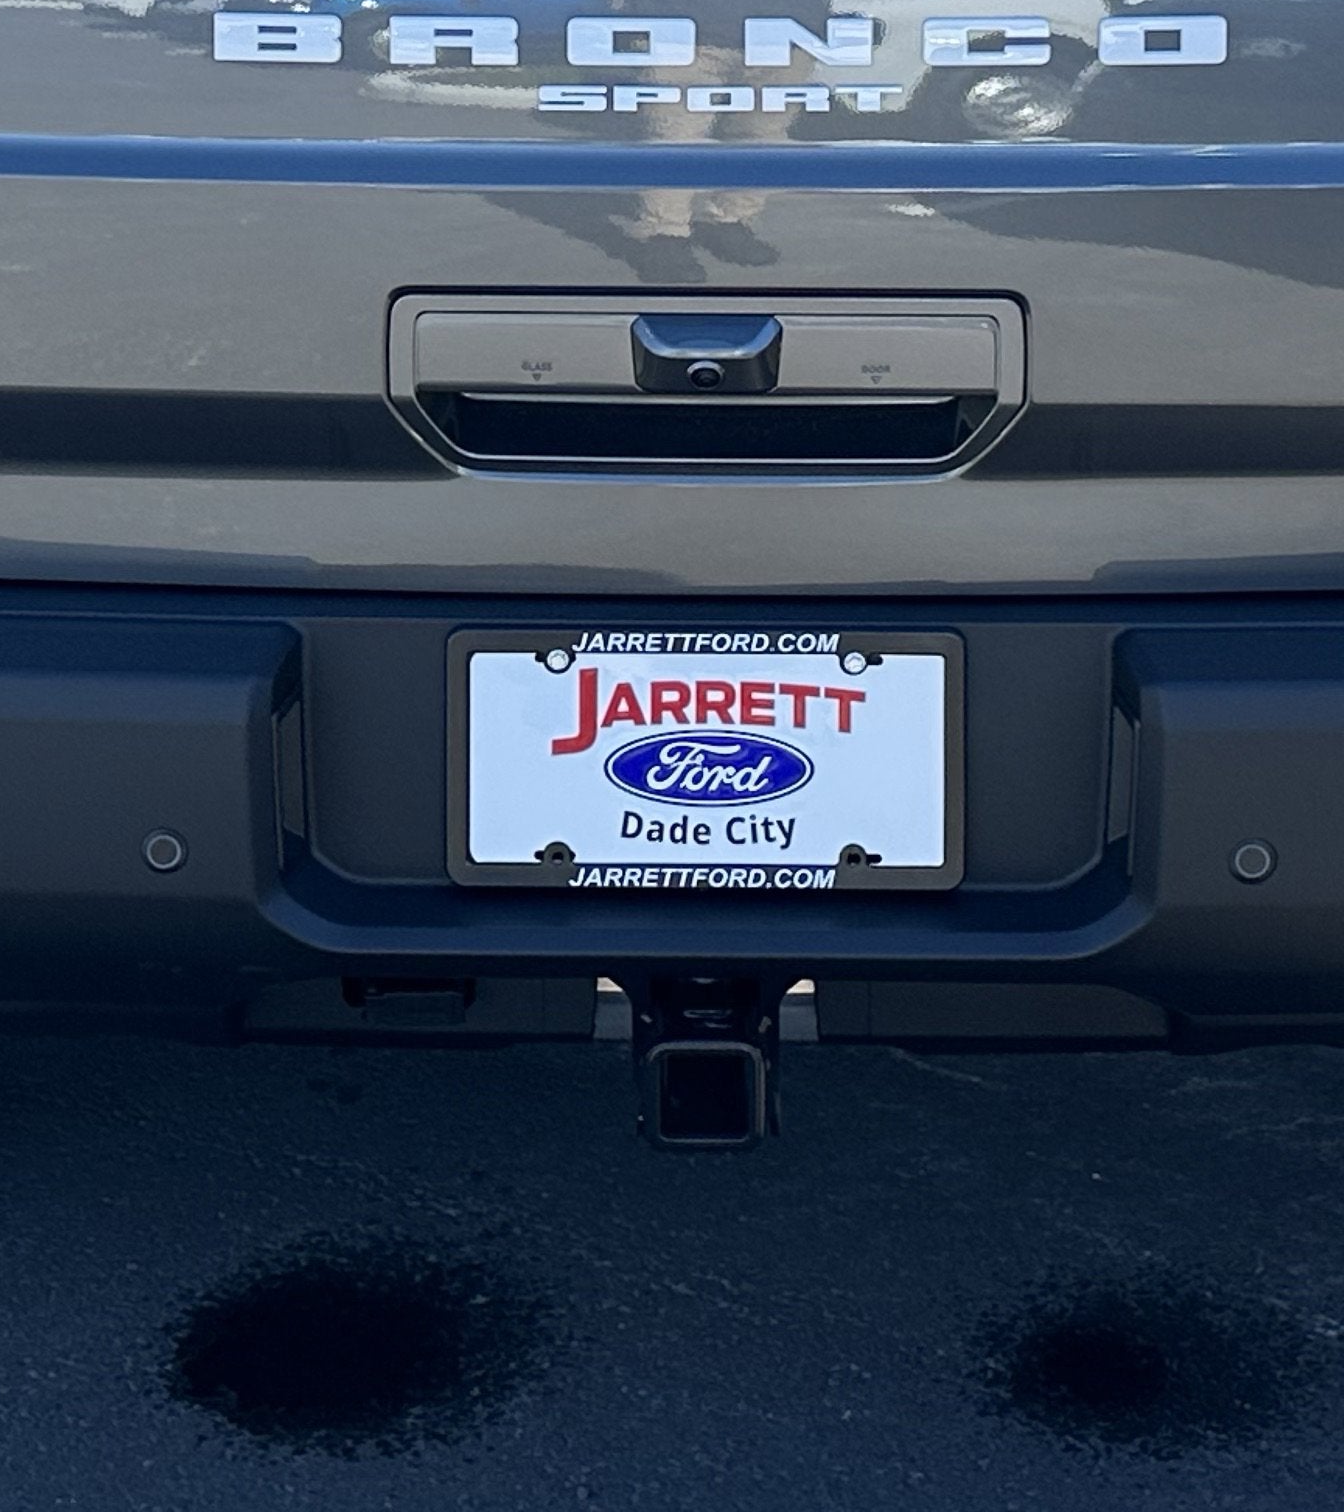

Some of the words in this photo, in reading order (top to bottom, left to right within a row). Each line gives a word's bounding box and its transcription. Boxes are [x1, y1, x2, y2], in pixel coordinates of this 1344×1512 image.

[213, 12, 1227, 67] BRONCO
[537, 84, 903, 113] SPORT
[572, 633, 840, 654] JARRETTFORD.COM
[551, 668, 867, 756] JARRETT
[646, 741, 773, 792] Ford
[621, 810, 712, 845] Dade
[725, 816, 796, 850] City
[568, 867, 836, 889] JARRETTFORD.COM
